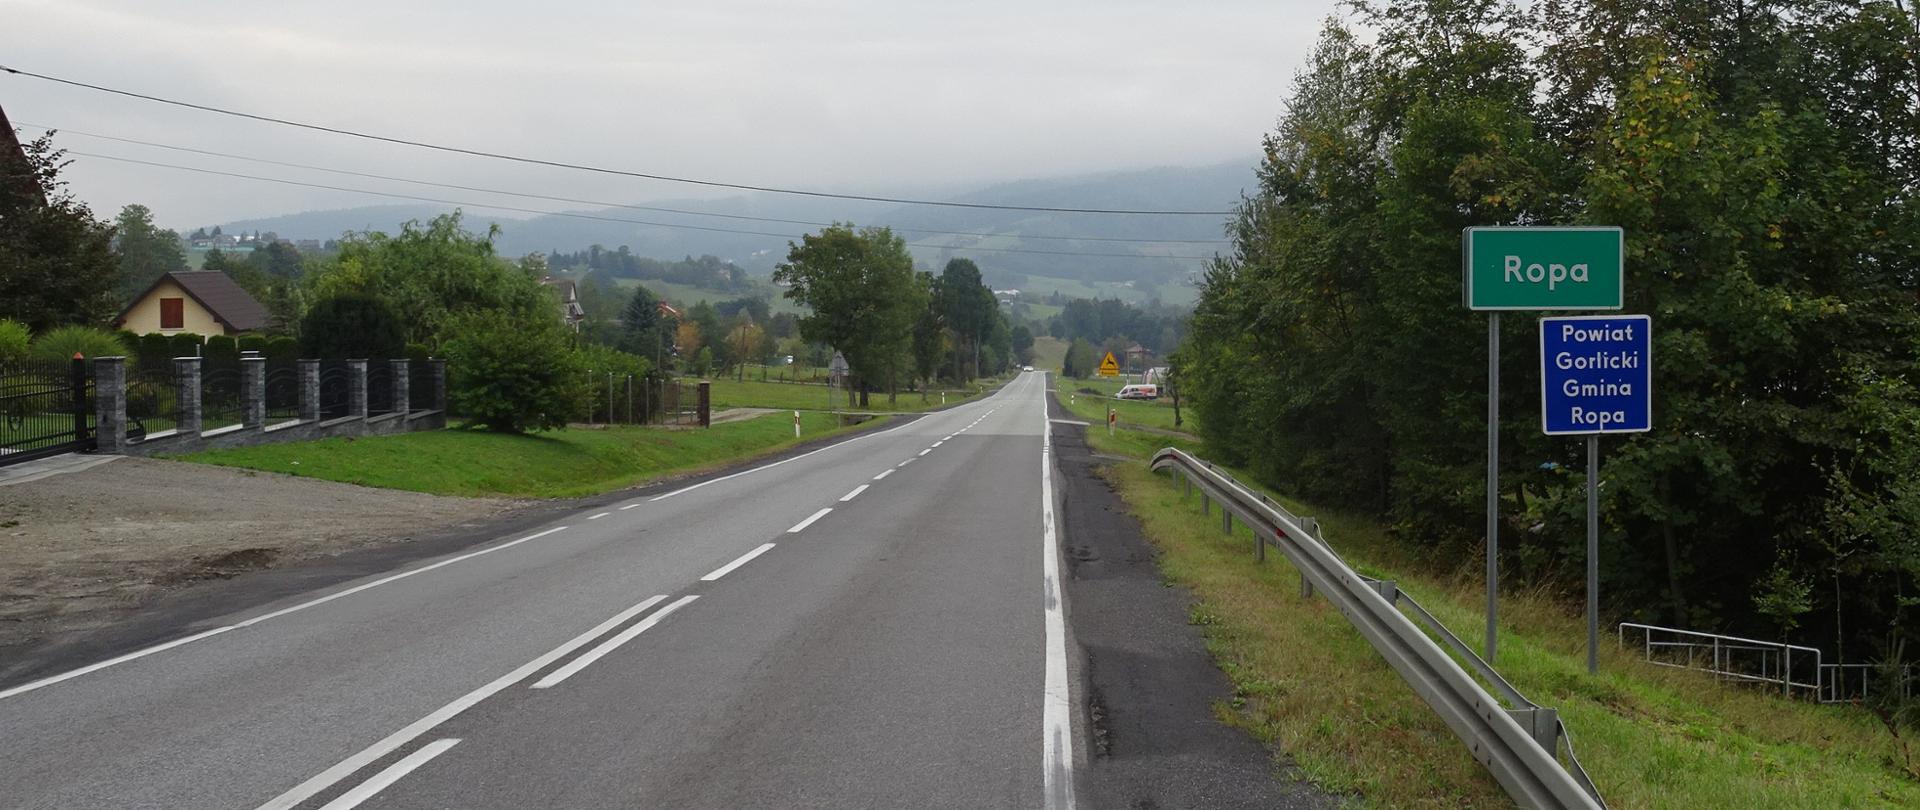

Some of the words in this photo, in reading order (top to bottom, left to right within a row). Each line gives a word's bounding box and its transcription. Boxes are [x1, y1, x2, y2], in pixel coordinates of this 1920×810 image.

[1504, 255, 1588, 290] Ropa
[1562, 324, 1633, 342] Powiat
[1556, 351, 1638, 370] Gorlicki
[1563, 379, 1631, 397] Gmina
[1571, 406, 1625, 430] Ropa
